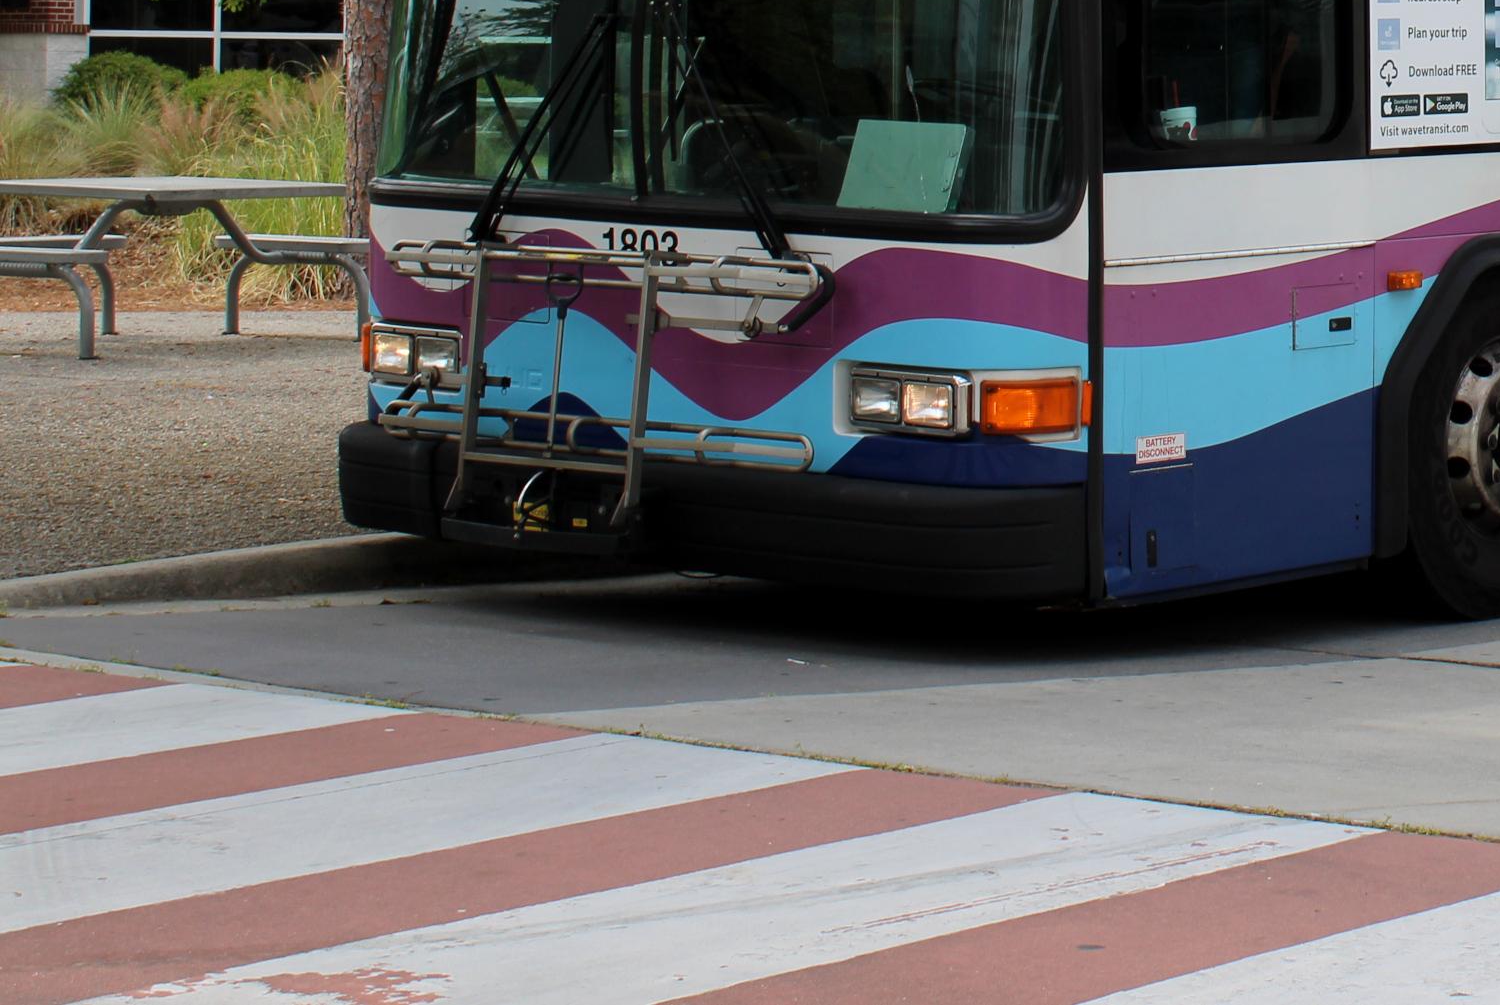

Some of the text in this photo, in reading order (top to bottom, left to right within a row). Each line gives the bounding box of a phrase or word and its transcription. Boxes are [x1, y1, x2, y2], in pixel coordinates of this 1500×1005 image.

[1408, 26, 1468, 41] Plan your trip
[1408, 63, 1477, 78] Download FREE
[1394, 103, 1418, 113] App Store
[1436, 101, 1467, 113] Google Play
[1380, 123, 1469, 137] Visit wavetransit.com
[602, 227, 679, 266] 1803
[1145, 436, 1176, 448] BATTERY
[1138, 446, 1184, 459] DISCONNECT
